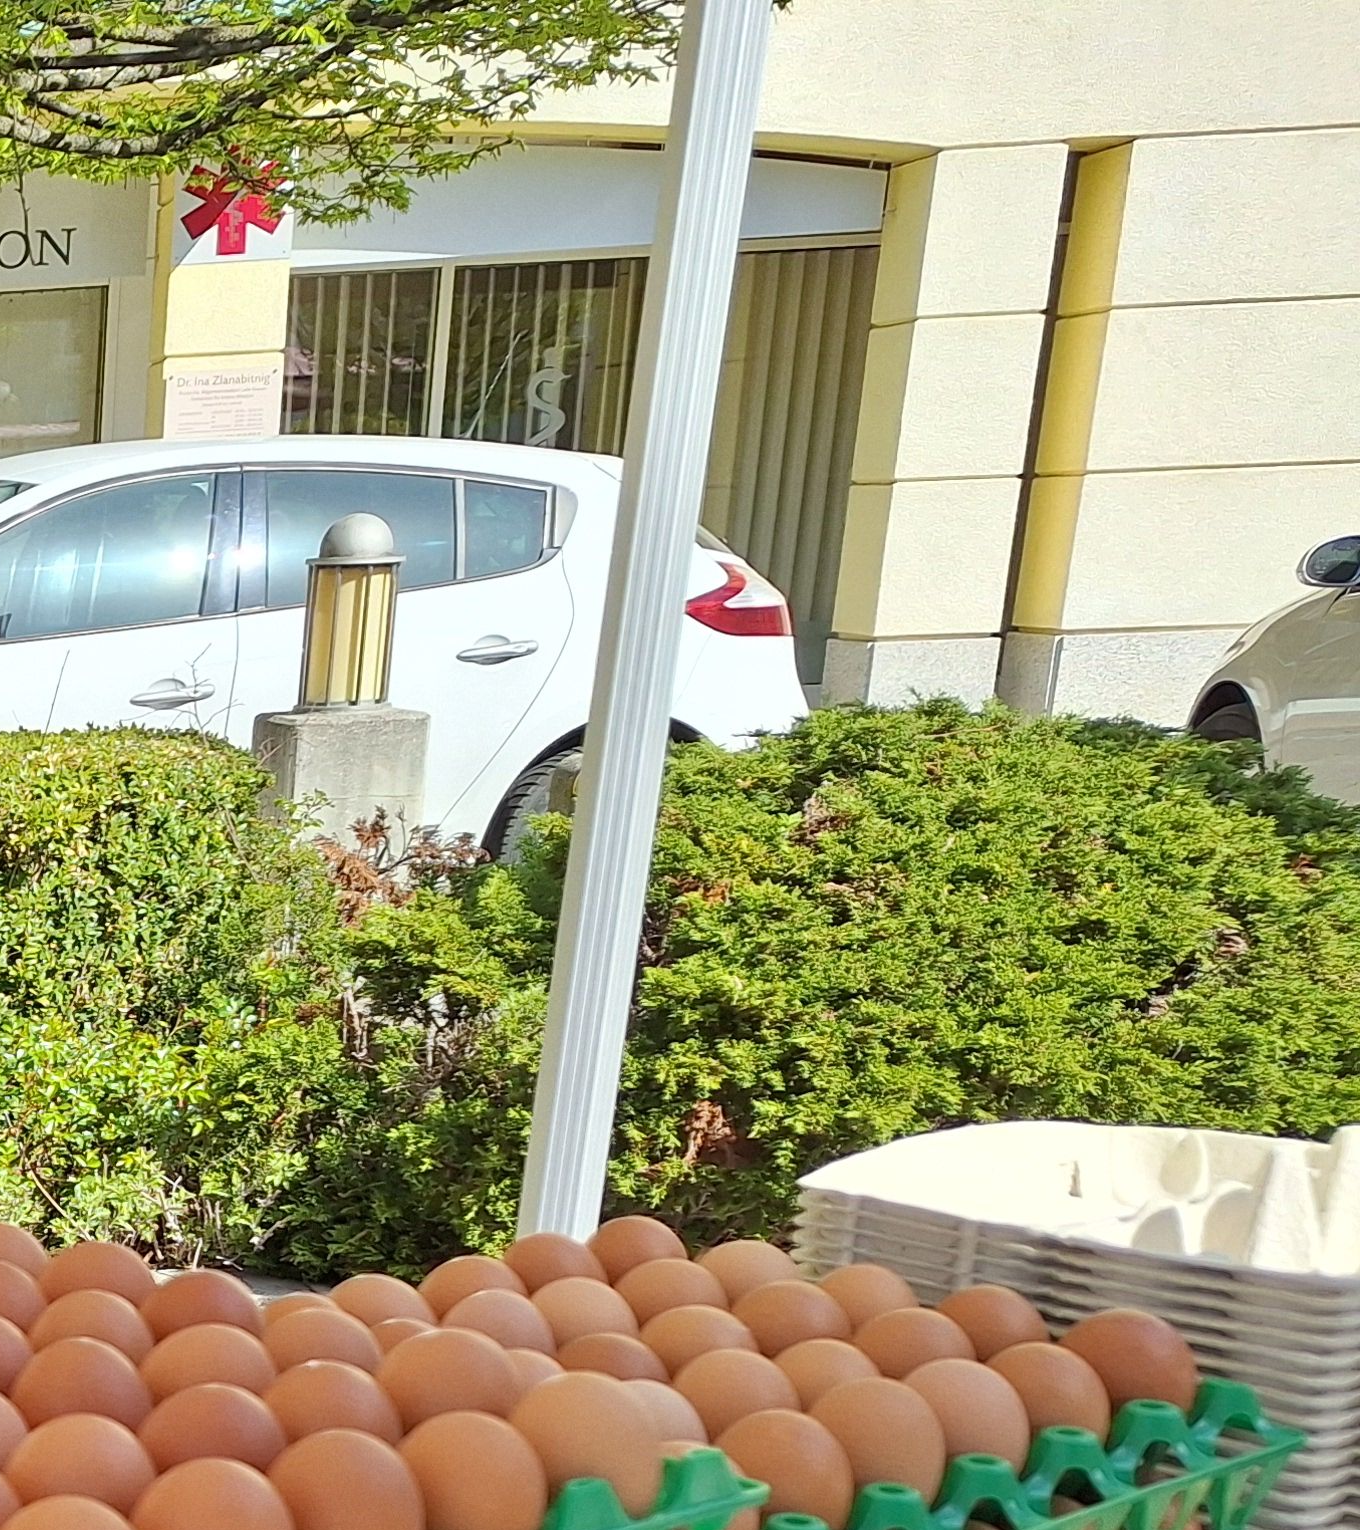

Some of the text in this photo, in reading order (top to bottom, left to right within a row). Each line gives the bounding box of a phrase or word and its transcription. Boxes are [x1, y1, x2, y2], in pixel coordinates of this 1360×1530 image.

[176, 373, 271, 388] Dr. Ina Zlanabitnig
